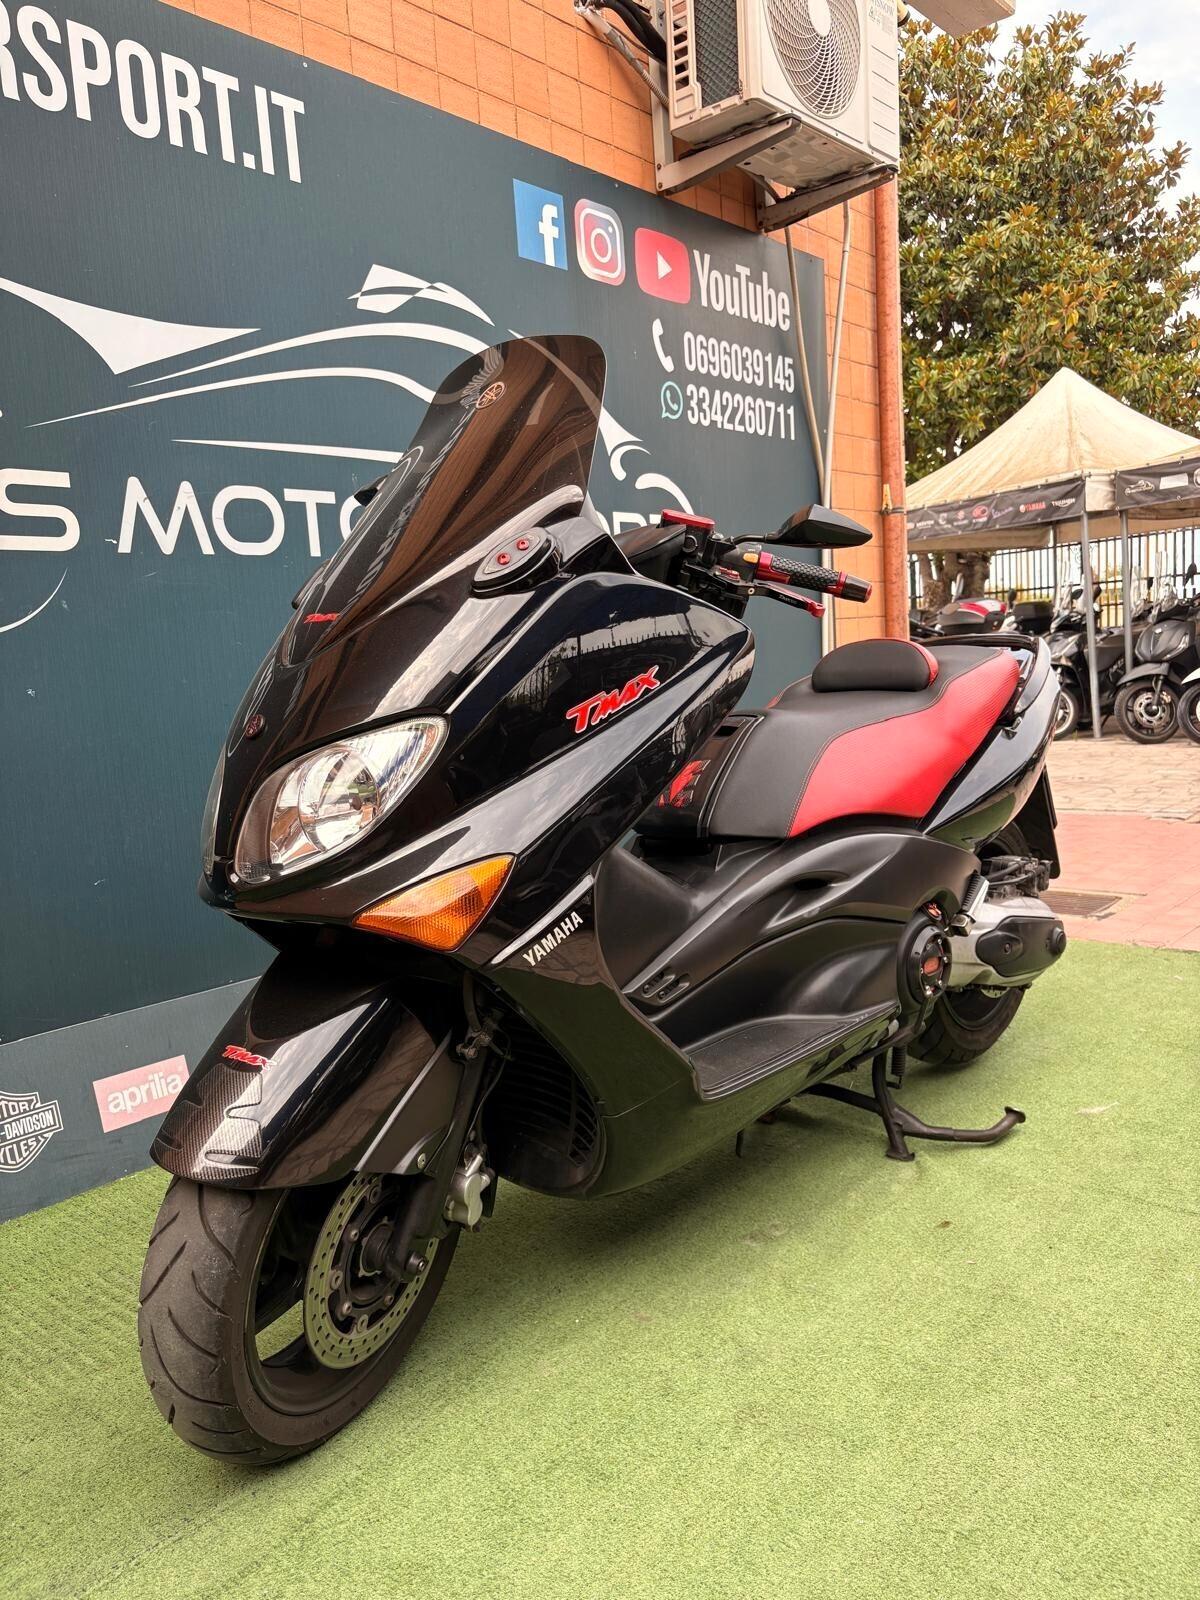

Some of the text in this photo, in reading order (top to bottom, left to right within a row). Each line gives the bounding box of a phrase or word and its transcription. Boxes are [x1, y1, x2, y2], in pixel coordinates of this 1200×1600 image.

[693, 250, 790, 332] YouTube
[683, 331, 795, 394] 0696039145
[686, 384, 795, 441] 3342260711
[522, 911, 584, 967] YAMAHA
[108, 1071, 183, 1114] aprilia
